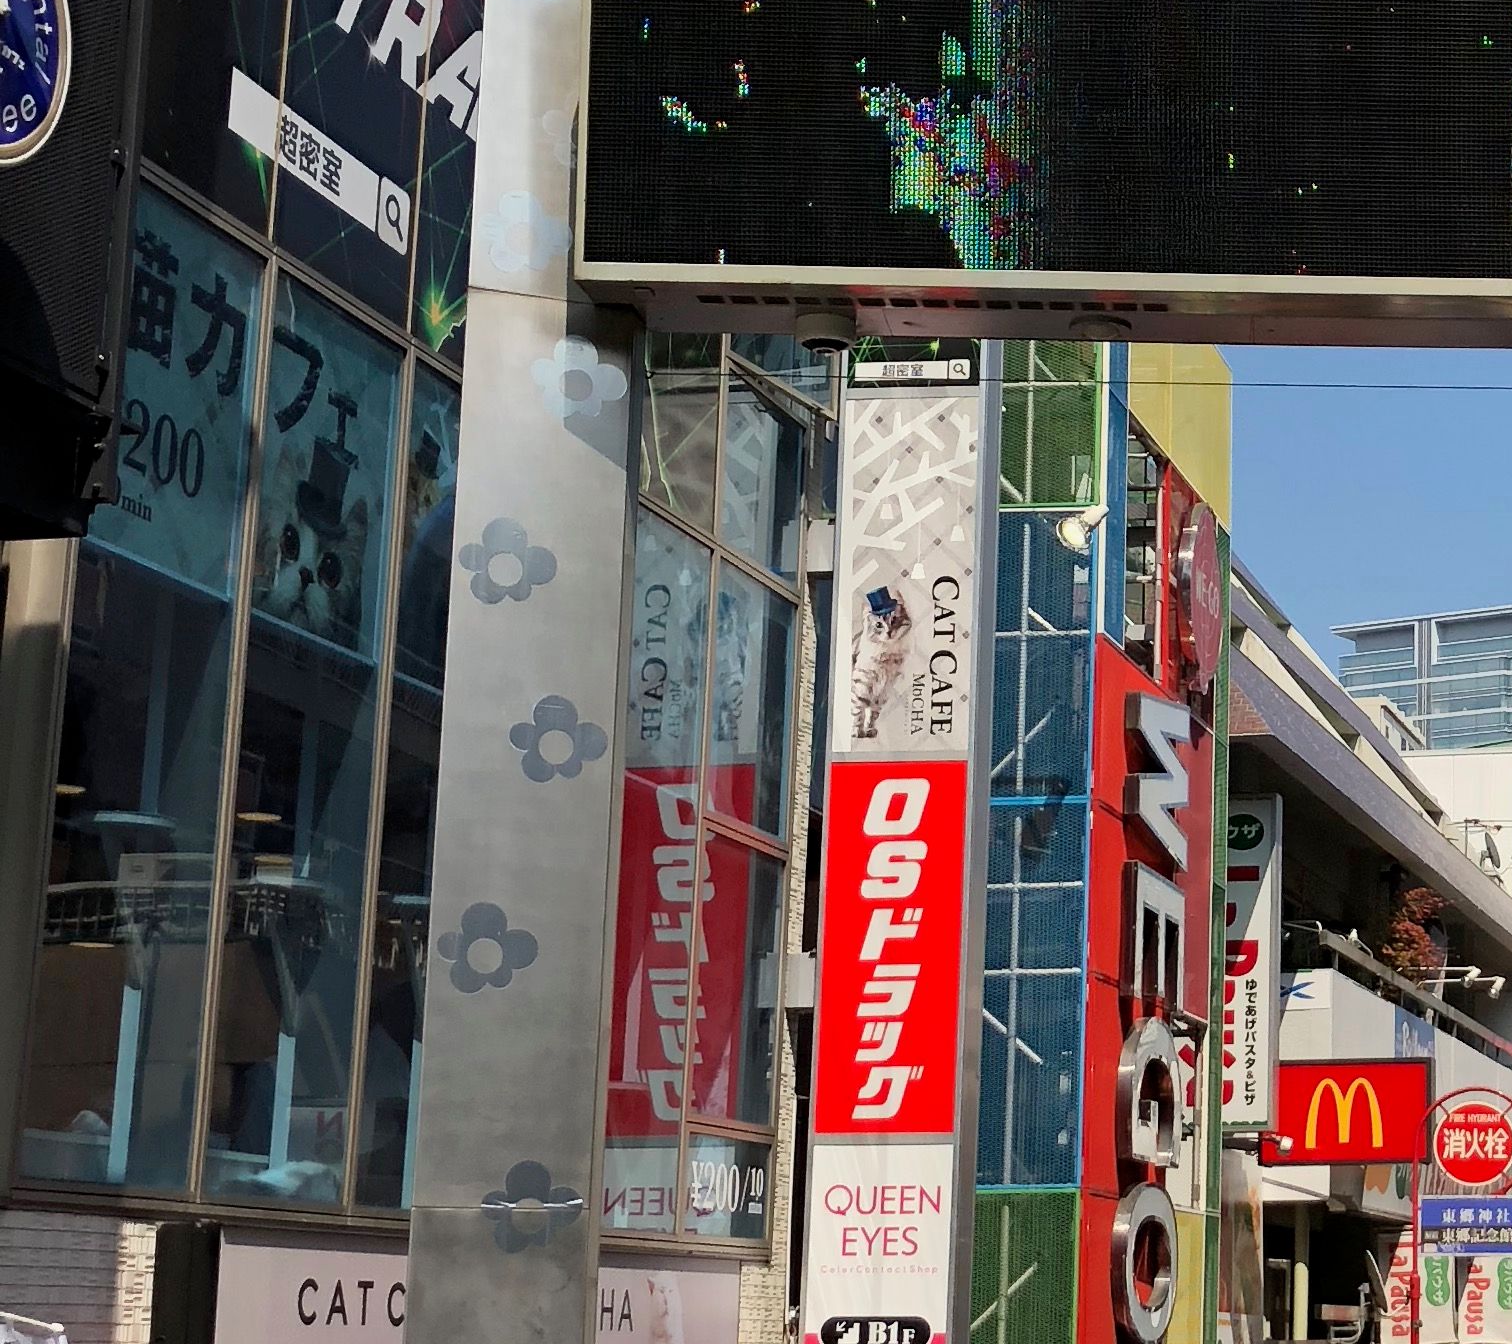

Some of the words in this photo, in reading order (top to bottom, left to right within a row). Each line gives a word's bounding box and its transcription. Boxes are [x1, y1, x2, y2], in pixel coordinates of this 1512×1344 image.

[276, 113, 344, 199] 超密室
[882, 363, 924, 378] 超密室
[932, 575, 960, 643] CAT
[929, 649, 958, 736] CAFE
[851, 777, 931, 1121] OSドラッグ
[1450, 1114, 1466, 1123] FIRE
[1468, 1114, 1501, 1123] HYDRANT
[1443, 1127, 1510, 1160] 消火栓
[825, 1184, 942, 1216] QUEEN
[1442, 1207, 1511, 1224] 東郷神社
[842, 1226, 919, 1258] EYES
[297, 1278, 370, 1329] CAT
